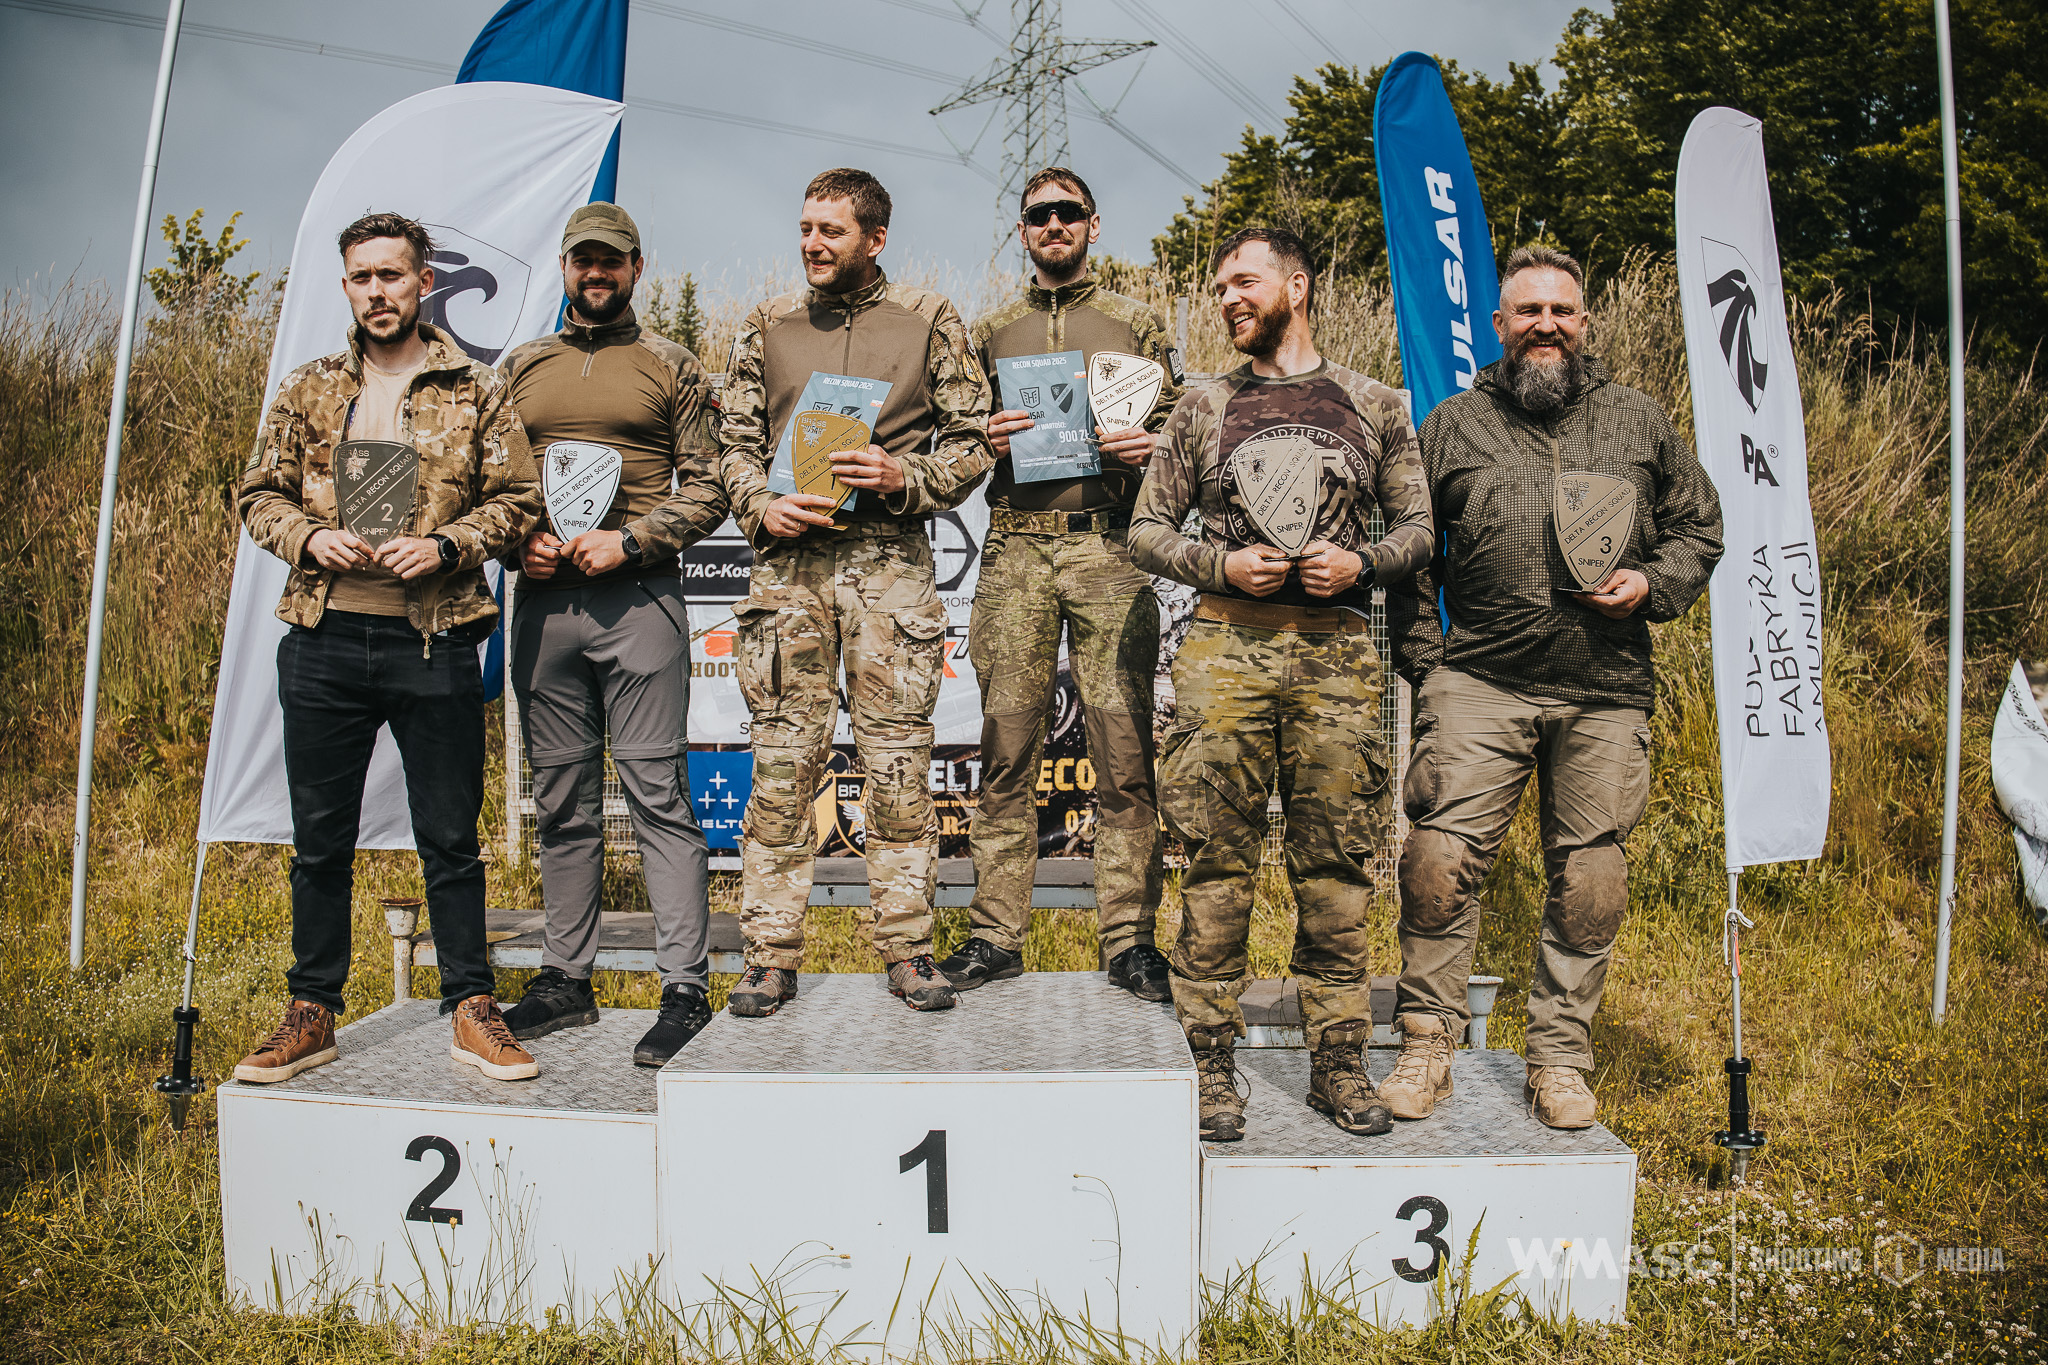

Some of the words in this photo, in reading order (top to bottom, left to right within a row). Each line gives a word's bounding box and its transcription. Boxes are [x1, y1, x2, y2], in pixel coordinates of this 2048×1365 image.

[1424, 166, 1479, 392] ULSAR
[1012, 360, 1031, 370] RECON
[1031, 358, 1052, 368] SQUAD
[1052, 356, 1067, 366] 2025
[822, 377, 840, 386] RECON
[840, 379, 860, 388] SQUAD
[858, 381, 875, 391] 2025
[1095, 393, 1115, 406] DELTA
[1115, 380, 1137, 395] RECON
[1136, 368, 1158, 383] SQUAD
[1028, 410, 1046, 420] USAR
[1106, 416, 1130, 427] SNIPER
[1058, 430, 1078, 444] 900
[552, 448, 578, 457] BRASS
[798, 463, 818, 480] DELTA
[841, 429, 865, 449] SQUAD
[345, 496, 368, 515] DELTA
[366, 474, 391, 497] RECON
[388, 453, 413, 476] SQUAD
[551, 491, 572, 507] DELTA
[571, 473, 594, 492] RECON
[593, 456, 617, 475] SQUAD
[1256, 494, 1275, 517] DELTA
[1271, 468, 1292, 494] RECON
[1288, 443, 1309, 469] SQUAD
[380, 502, 394, 522] 2
[582, 498, 595, 516] 2
[1292, 496, 1307, 516] 3
[1563, 526, 1586, 545] DELTA
[1584, 506, 1609, 528] RECON
[1608, 487, 1631, 508] SQUAD
[562, 518, 588, 528] SNIPER
[1228, 505, 1248, 536] ALBO
[1276, 521, 1305, 534] SNIPER
[361, 526, 389, 537] SNIPER
[1599, 535, 1612, 555] 3
[1577, 557, 1605, 568] SNIPER
[1751, 543, 1807, 737] FABRYKA
[691, 661, 740, 678] HOOT
[928, 758, 983, 792] ELT
[1035, 757, 1097, 792] ECO
[697, 818, 743, 830] ELT
[404, 1135, 463, 1226] 2
[899, 1129, 949, 1234] 1
[1391, 1195, 1450, 1284] 3
